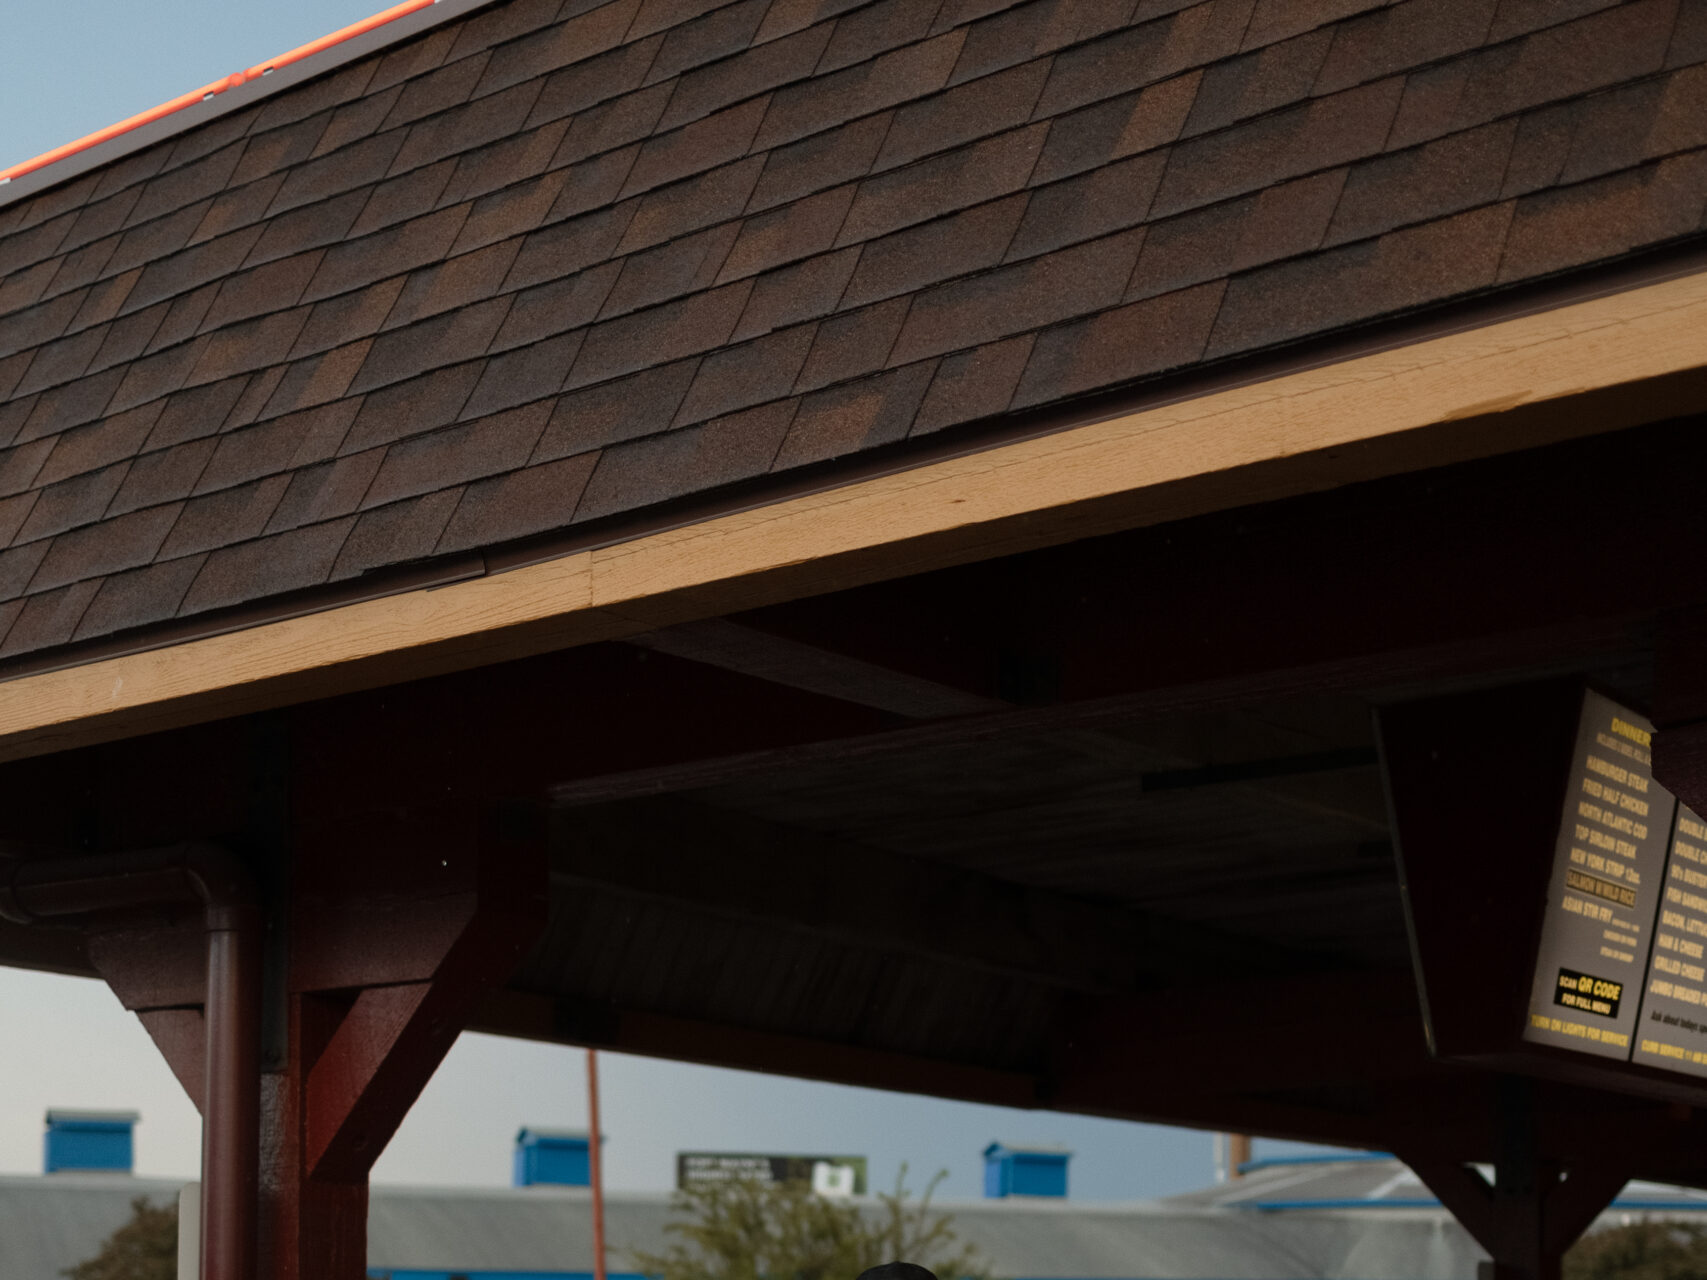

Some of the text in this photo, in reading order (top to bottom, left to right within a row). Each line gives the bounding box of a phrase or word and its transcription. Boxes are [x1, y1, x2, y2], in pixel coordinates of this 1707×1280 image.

[1575, 823, 1589, 841] TOP
[1559, 975, 1621, 1001] SCAN QR CODE
[1561, 993, 1576, 1006] FOR
[1576, 996, 1592, 1010] FULL
